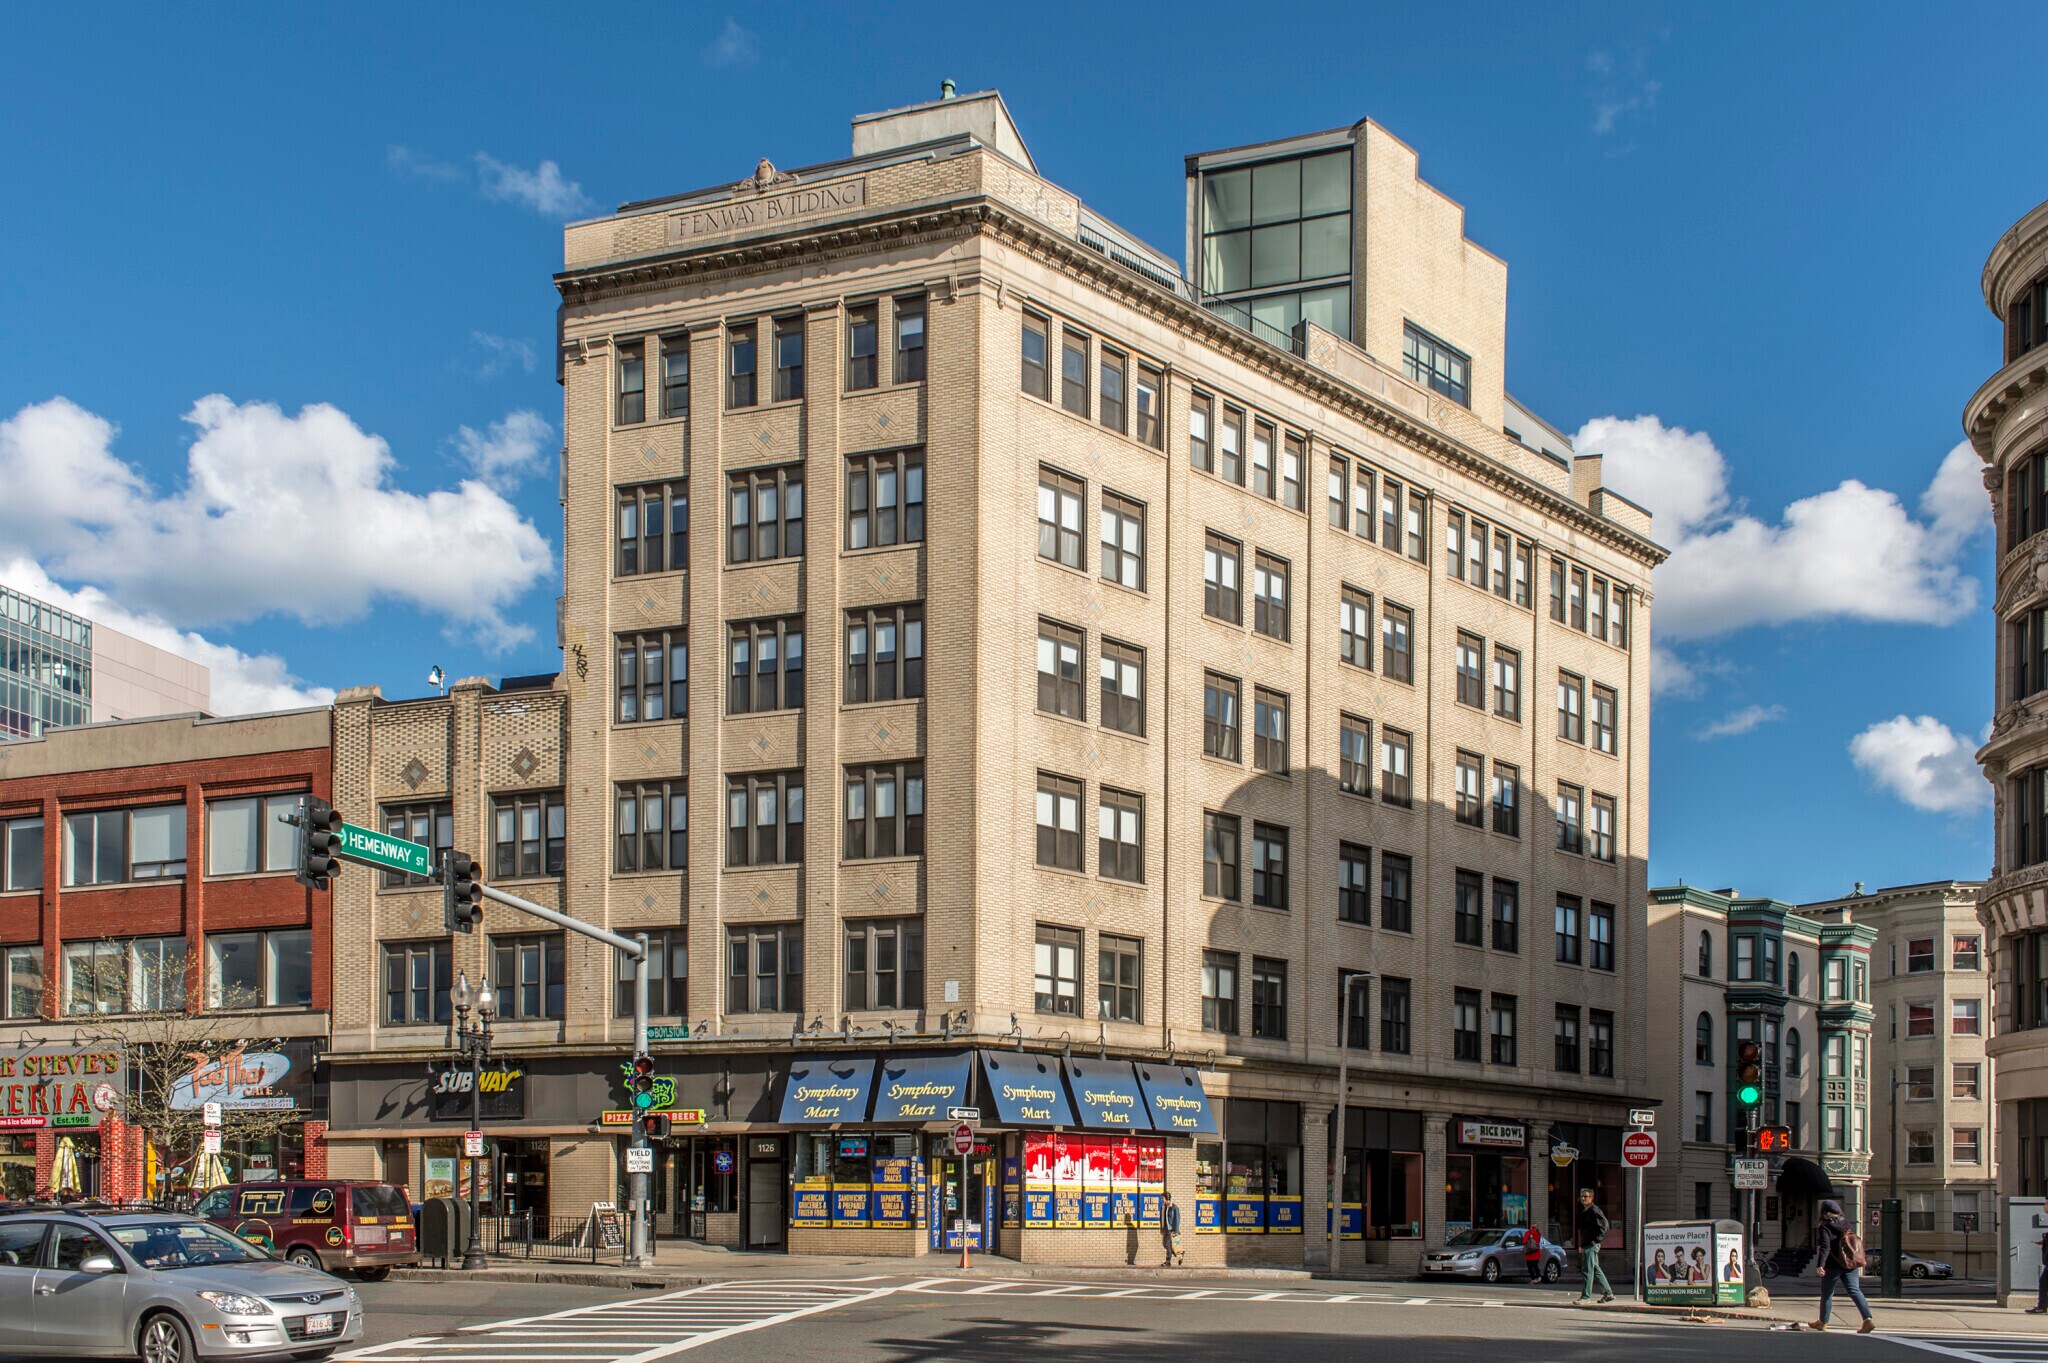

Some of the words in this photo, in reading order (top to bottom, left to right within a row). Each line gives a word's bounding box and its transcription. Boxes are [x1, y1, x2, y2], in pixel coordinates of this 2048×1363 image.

[679, 205, 762, 236] FENWAY
[767, 184, 856, 219] BVILDING
[349, 831, 411, 863] HEMENWAY
[415, 857, 425, 867] ST
[654, 1027, 685, 1038] BOYLSTON
[24, 1052, 119, 1077] STEVE'S
[793, 1084, 859, 1101] Symphony
[887, 1082, 955, 1100] Symphony
[1003, 1085, 1056, 1103] Symphony
[1084, 1090, 1134, 1107] Symphony
[1156, 1096, 1202, 1112] Symphony
[803, 1106, 840, 1119] Mart
[899, 1104, 936, 1116] Mart
[1021, 1106, 1051, 1120] Mart
[607, 1113, 633, 1122] PIZZA
[671, 1112, 695, 1121] BEER
[1101, 1111, 1130, 1123] Mart
[1172, 1115, 1198, 1128] Mart
[1480, 1125, 1498, 1137] RICE
[1500, 1126, 1523, 1139] BOWL
[662, 1139, 680, 1148] 1124
[1780, 1133, 1788, 1147] 5
[531, 1141, 548, 1151] 1122
[758, 1144, 774, 1152] 1126
[1739, 1161, 1764, 1170] YIELD
[1008, 1166, 1017, 1177] ATM
[802, 1194, 825, 1202] AMERICAN
[838, 1194, 867, 1202] SANDWICHES
[798, 1201, 822, 1209] GROCERIES
[842, 1202, 865, 1210] PREPARED
[844, 1209, 858, 1217] FOODS
[883, 1210, 903, 1218] SPANISH
[1646, 1233, 1664, 1241] Need
[1686, 1231, 1709, 1240] Place?
[950, 1237, 978, 1247] WELOME
